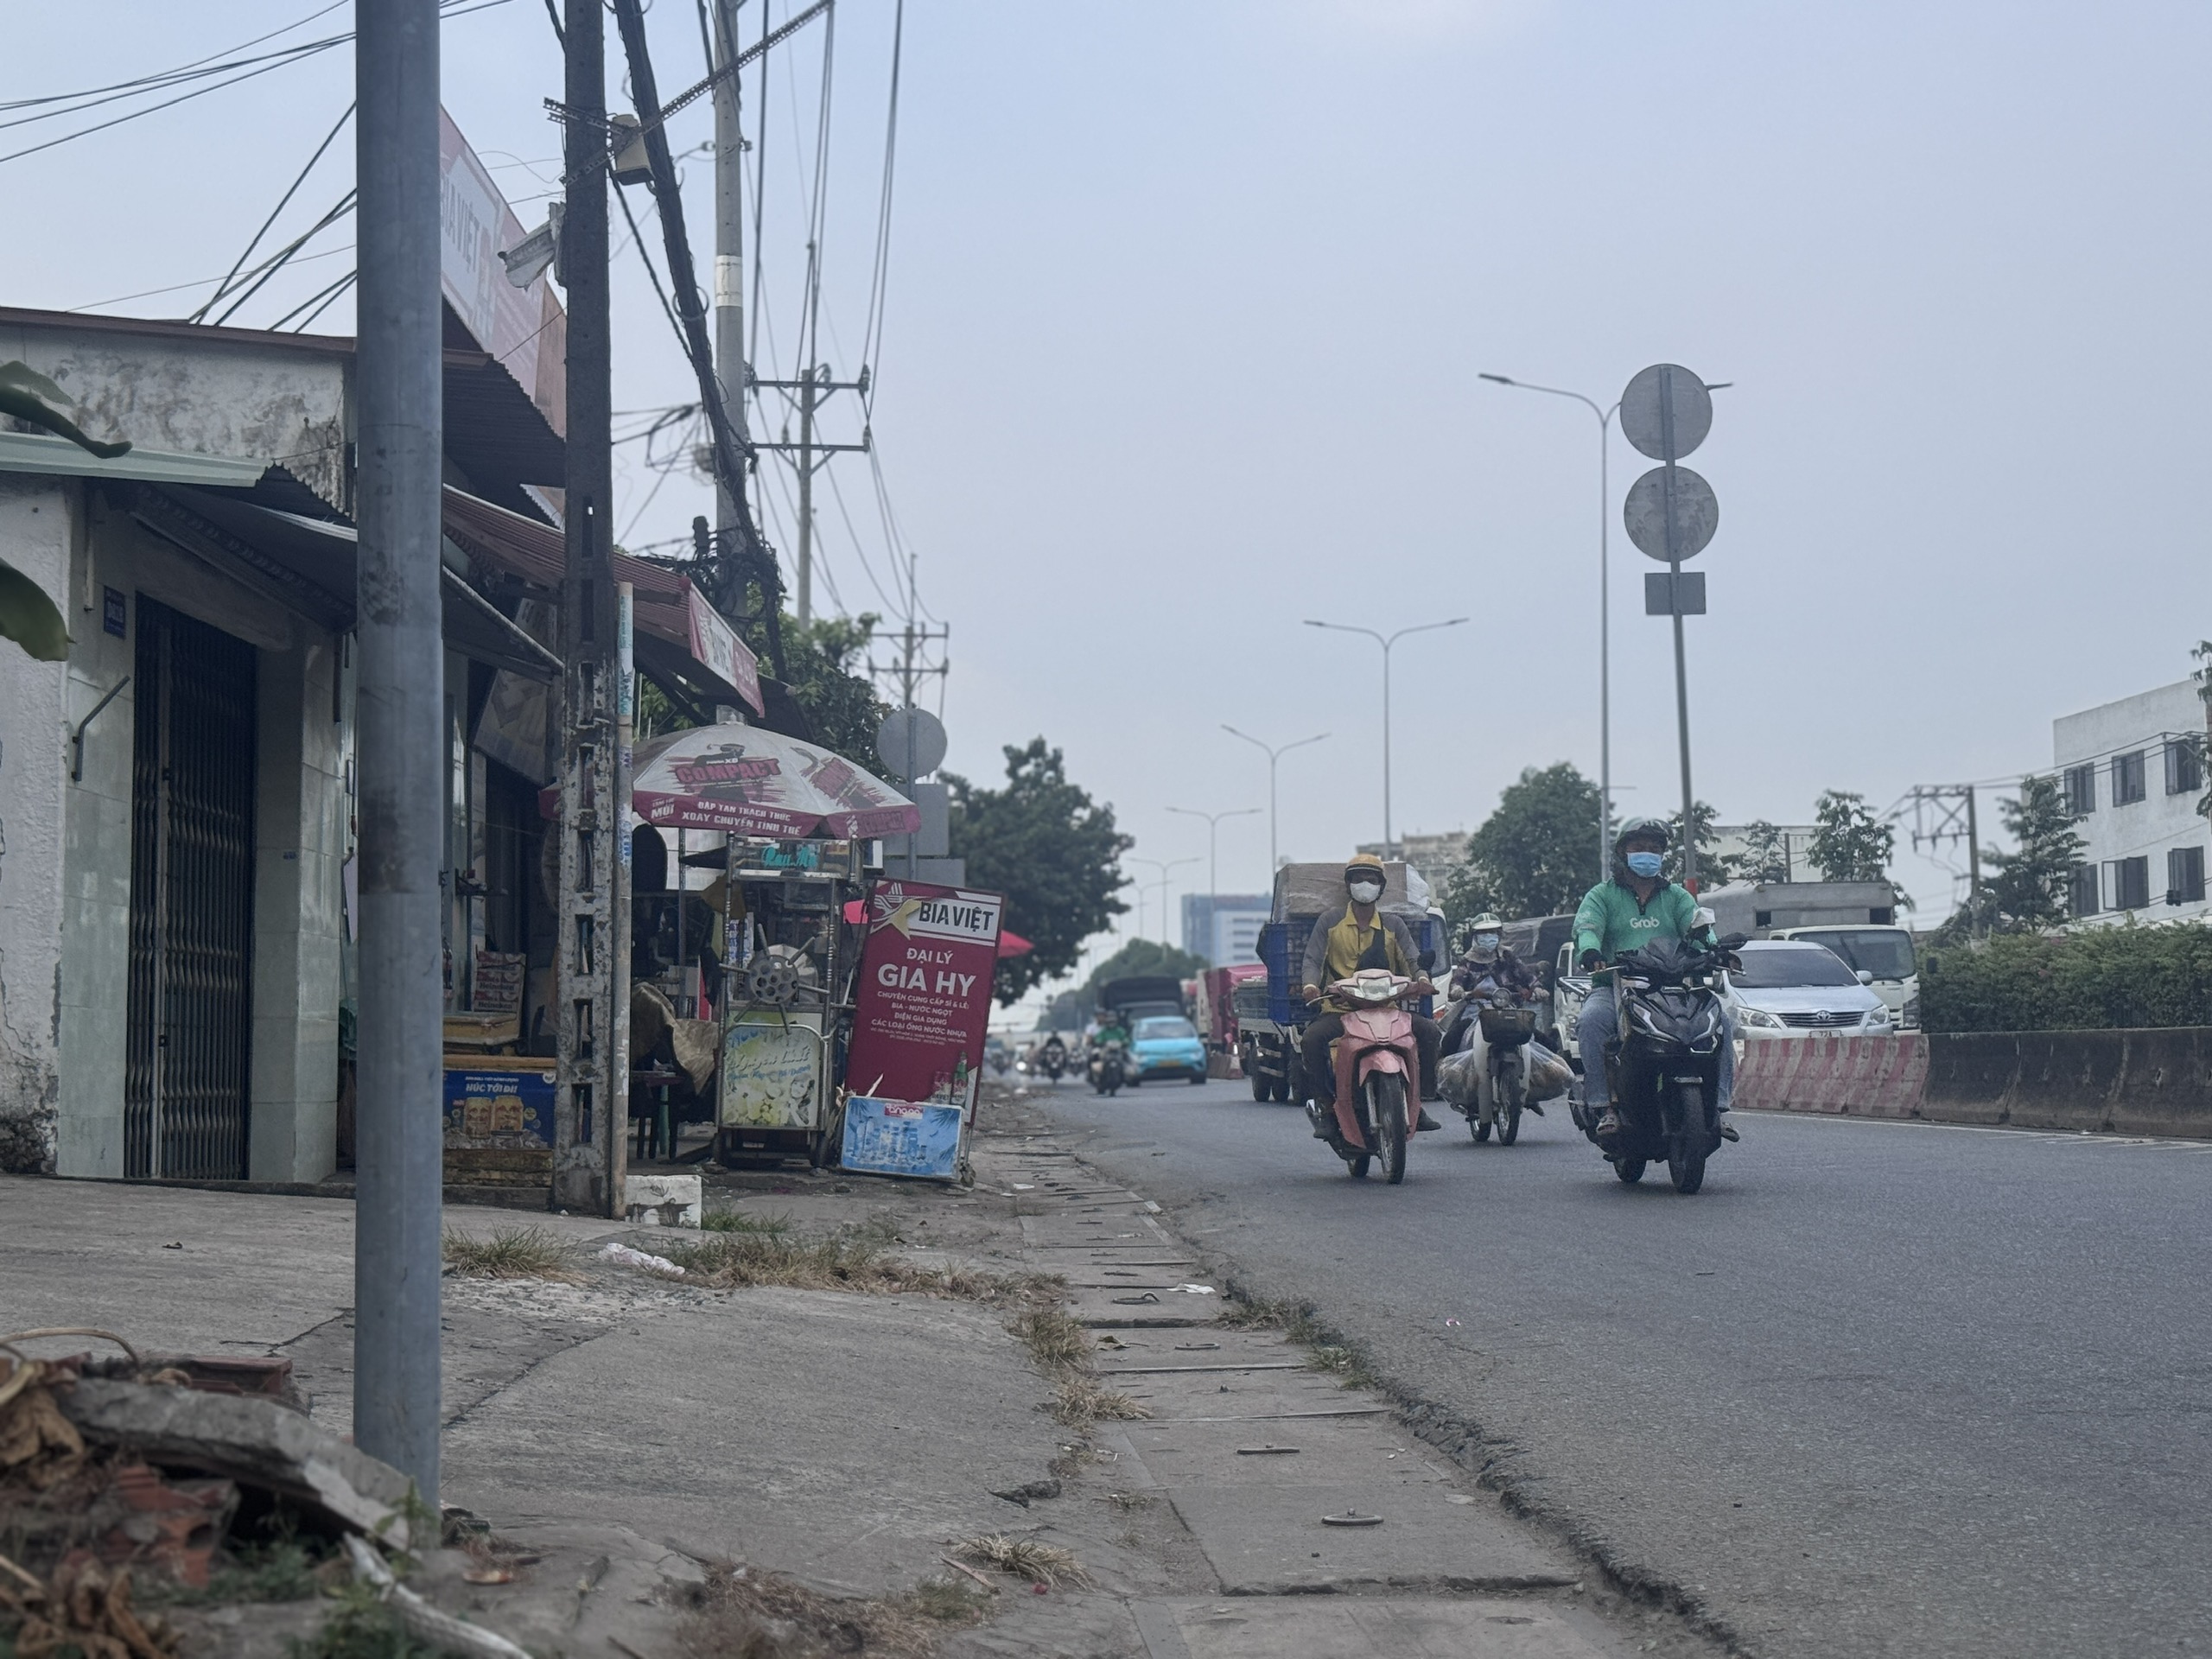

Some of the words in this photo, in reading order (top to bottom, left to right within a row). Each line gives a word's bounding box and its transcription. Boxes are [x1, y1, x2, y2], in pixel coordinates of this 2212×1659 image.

[676, 758, 782, 784] COMPACT
[719, 804, 736, 813] TAN
[682, 811, 710, 823] XOAY
[918, 901, 950, 925] BIA
[952, 906, 995, 932] VIỆT
[1630, 916, 1660, 929] Grab
[906, 947, 933, 964] ĐẠI
[936, 950, 954, 965] LÝ
[877, 963, 928, 993] GIA
[935, 970, 977, 997] HY
[876, 990, 906, 1001] CHUYÊN
[907, 995, 928, 1004] CUNG
[929, 996, 944, 1006] CẤP
[478, 1001, 513, 1010] Heineken
[909, 1004, 931, 1014] NƯỚC
[932, 1007, 953, 1017] NGỌT
[893, 1012, 912, 1021] ĐIỆN
[926, 1016, 948, 1026] DỤNG
[871, 1018, 887, 1027] CÁC
[888, 1020, 906, 1030] LOẠI
[906, 1021, 923, 1032] ỐNG
[924, 1025, 946, 1035] NƯỚC
[946, 1029, 968, 1039] NHỰA
[466, 1082, 486, 1092] HÚC
[487, 1083, 504, 1093] TỚI
